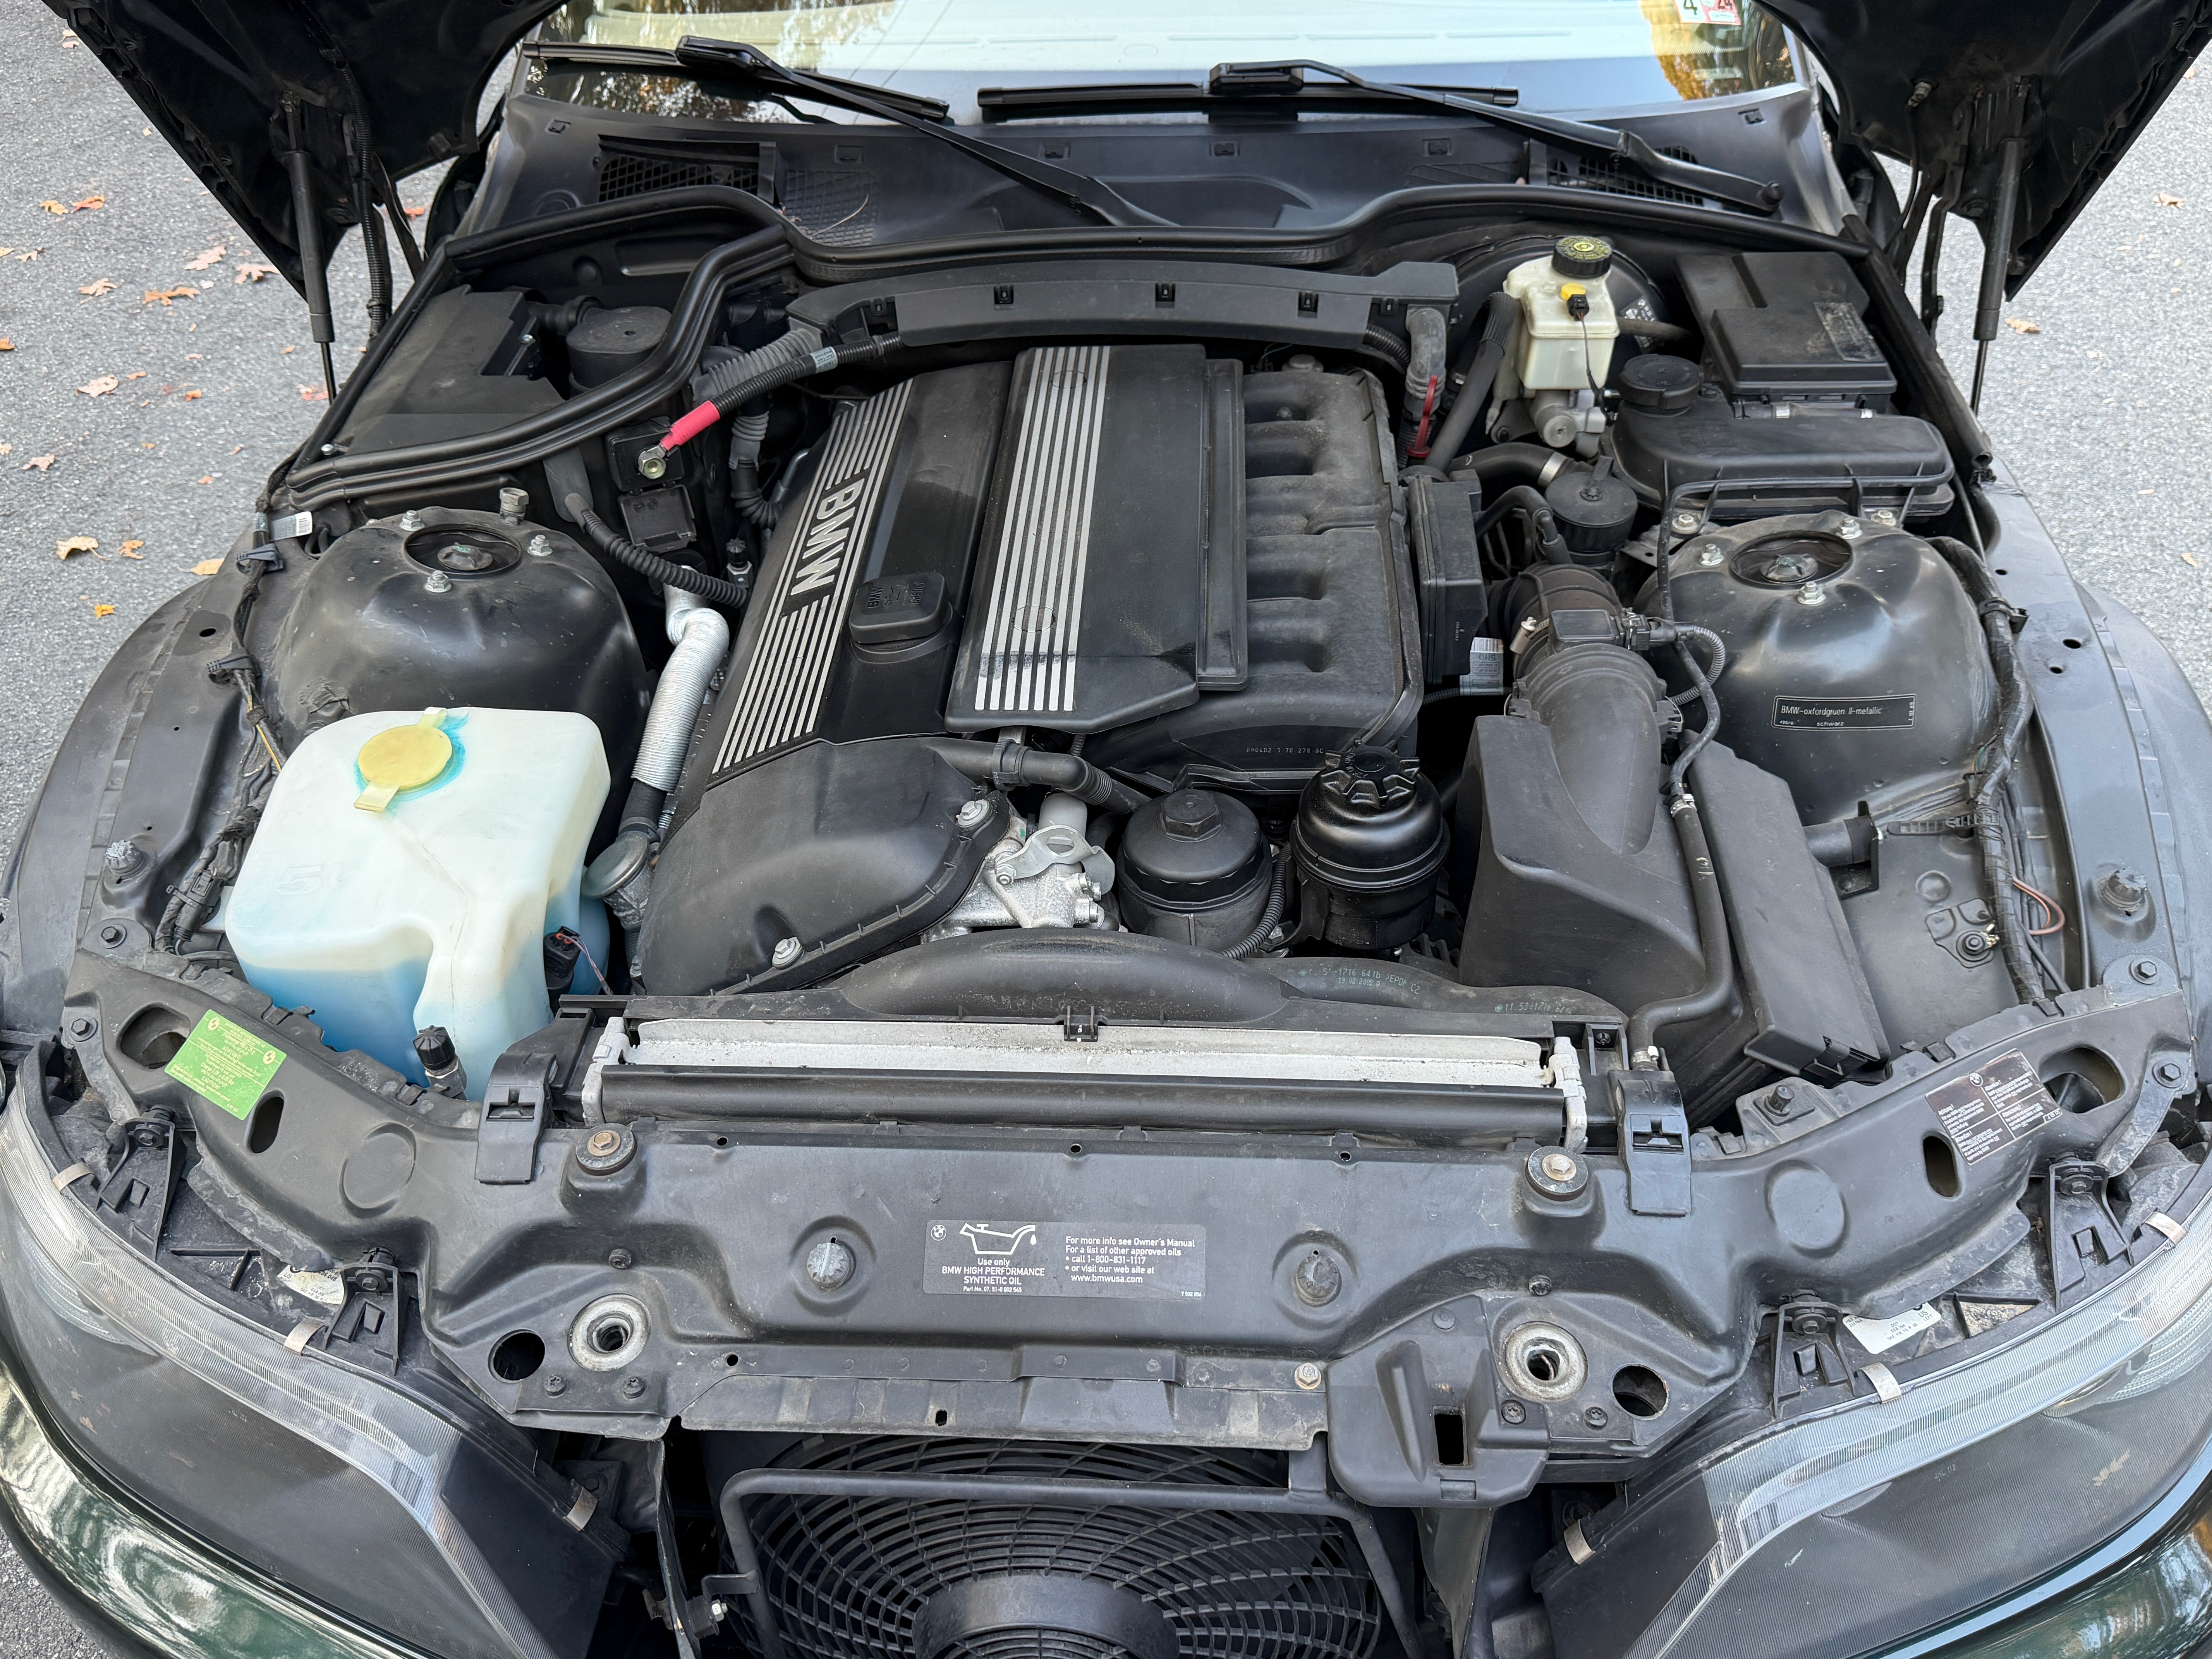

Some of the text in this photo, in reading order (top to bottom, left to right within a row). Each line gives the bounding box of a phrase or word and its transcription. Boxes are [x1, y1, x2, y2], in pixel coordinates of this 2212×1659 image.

[1683, 0, 1698, 15] 4
[791, 478, 866, 596] BMW
[867, 587, 883, 608] BMW
[1781, 706, 1845, 717] BMW-oxfordgruen
[222, 1046, 242, 1060] ACHTUNG!
[202, 1077, 220, 1089] CAUTION!
[1066, 1236, 1079, 1244] For
[1103, 1237, 1116, 1245] info
[1133, 1238, 1165, 1247] Owner's
[1167, 1238, 1195, 1247] Manual
[1065, 1245, 1079, 1253] For
[1109, 1246, 1129, 1254] other
[1130, 1248, 1166, 1256] approved
[1168, 1248, 1182, 1256] oils
[994, 1257, 1010, 1267] only
[1087, 1255, 1146, 1264] 1-800-831-1117
[963, 1266, 983, 1274] HIGH
[985, 1267, 1045, 1276] PERFORMANCE
[1082, 1264, 1097, 1272] visit
[1113, 1265, 1130, 1273] web
[1131, 1266, 1145, 1274] site
[963, 1276, 1007, 1285] SYNTHETIC
[1071, 1274, 1143, 1283] www.bmwusa.com
